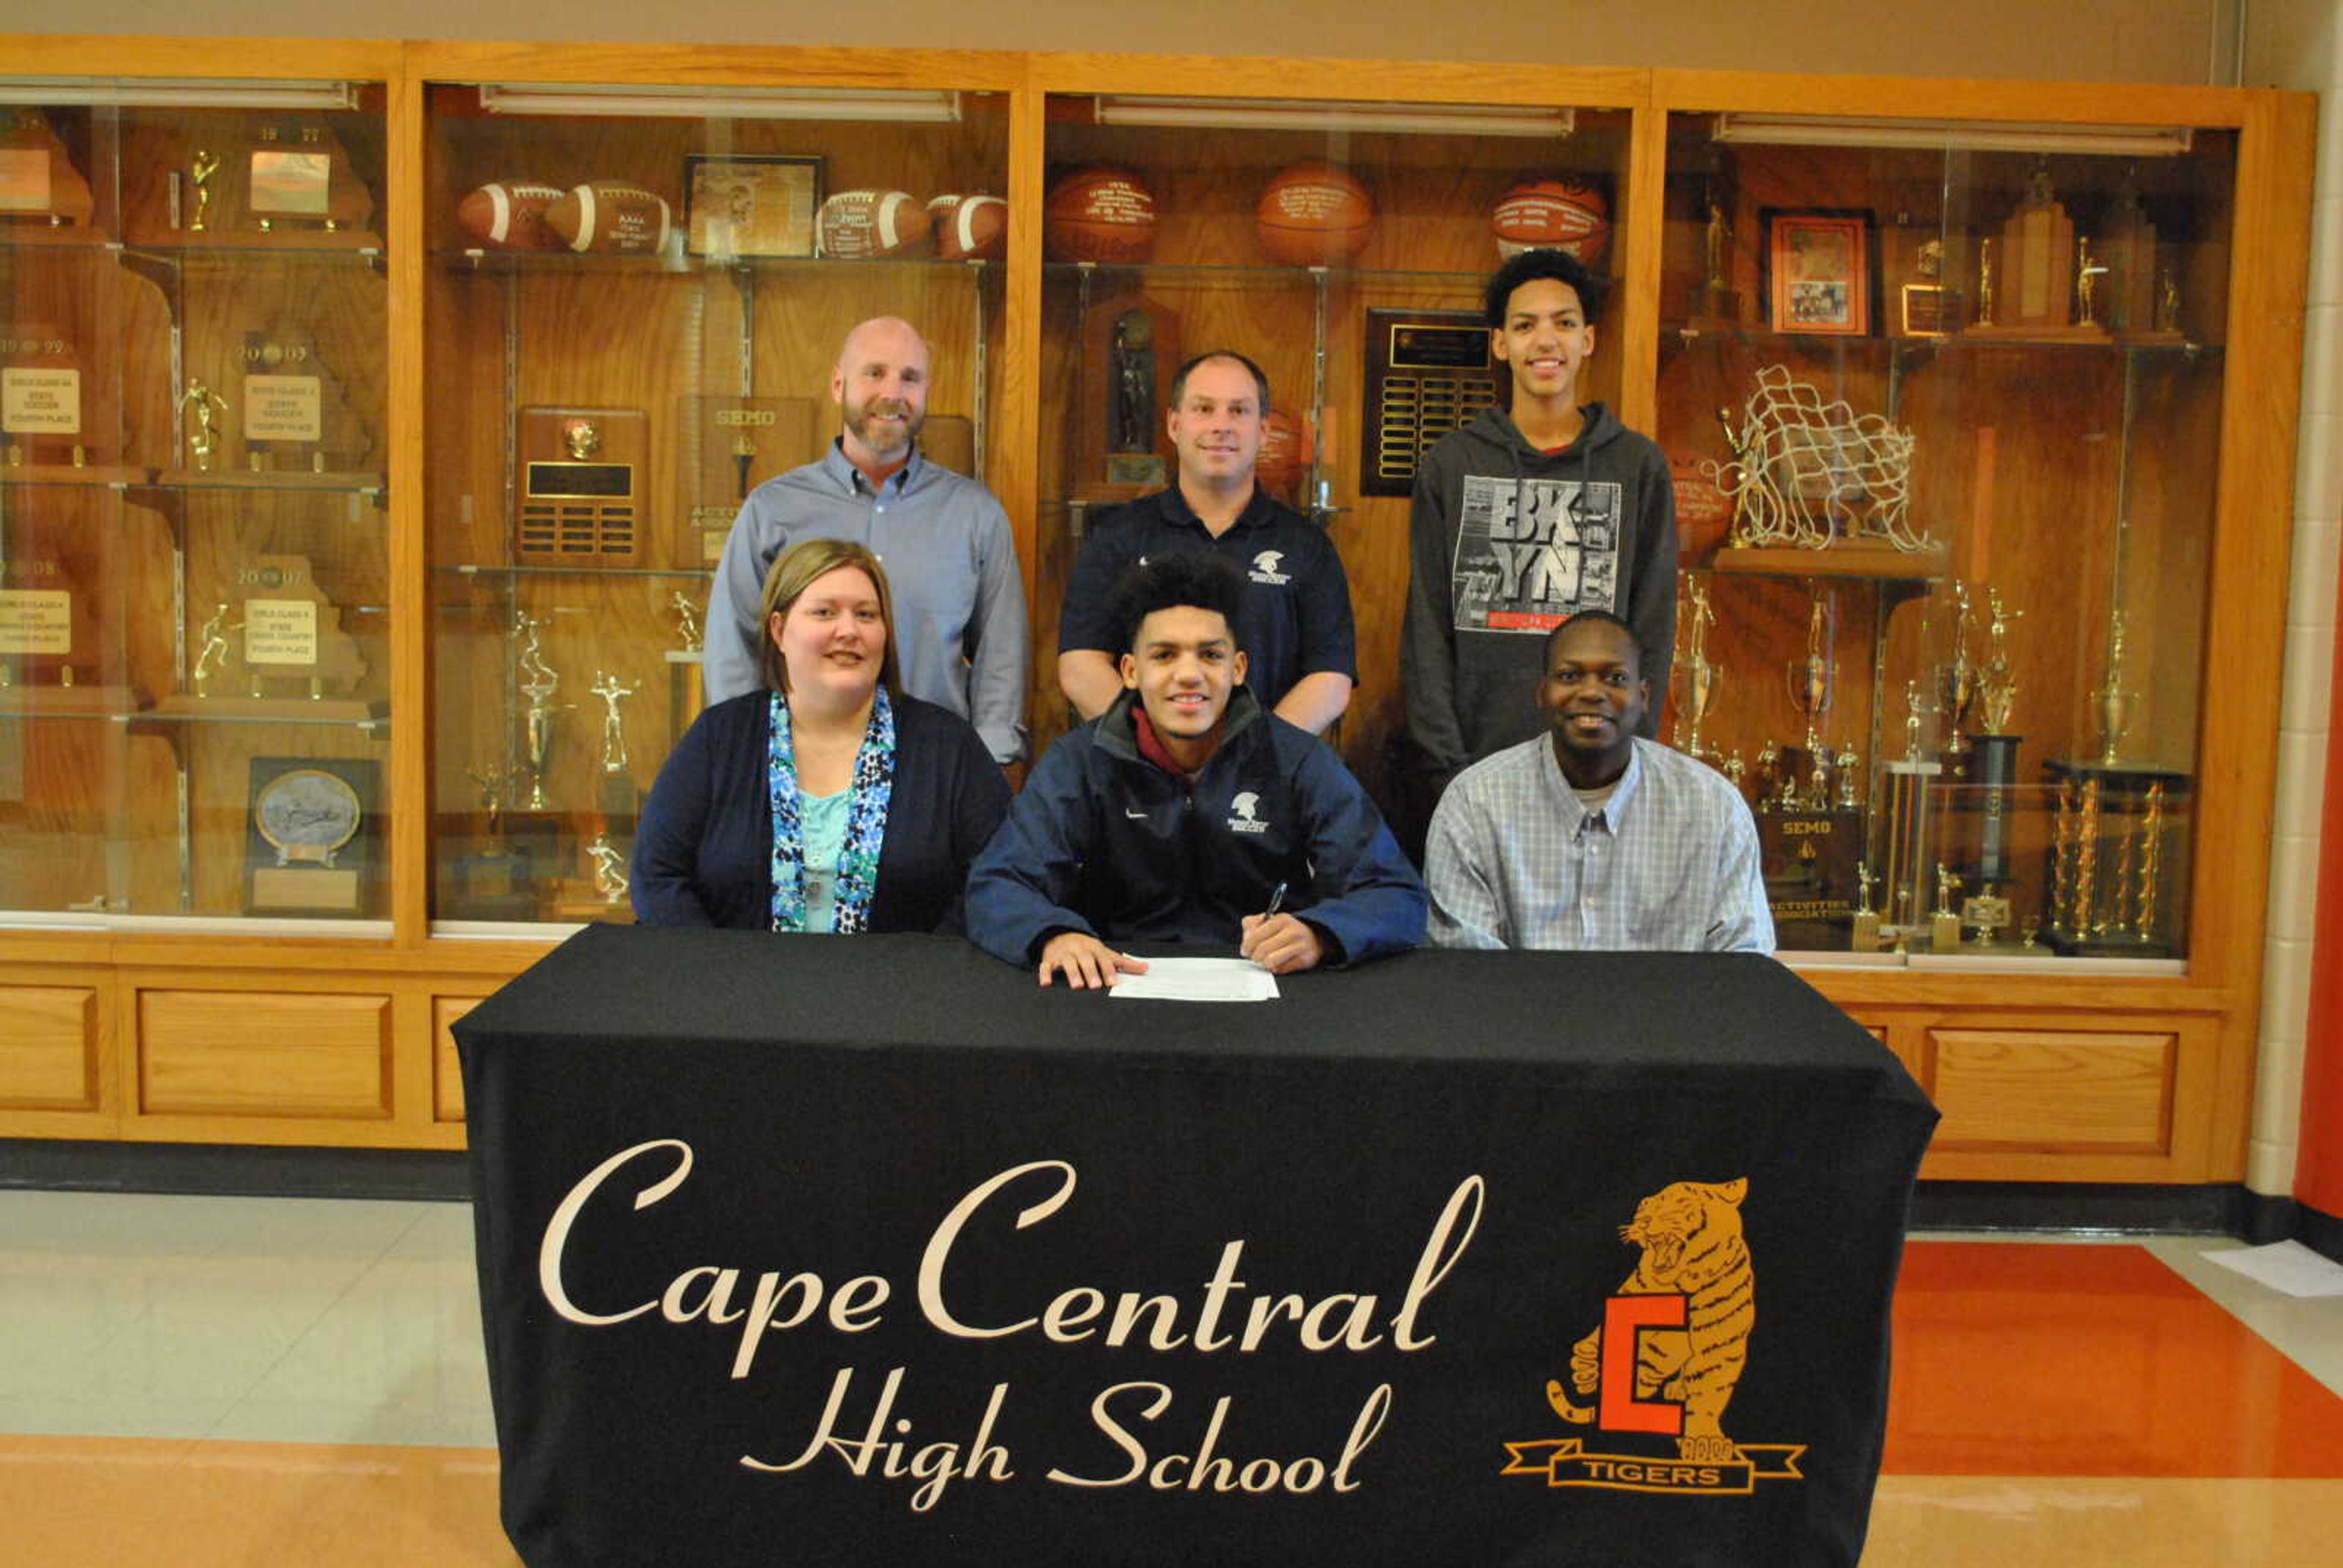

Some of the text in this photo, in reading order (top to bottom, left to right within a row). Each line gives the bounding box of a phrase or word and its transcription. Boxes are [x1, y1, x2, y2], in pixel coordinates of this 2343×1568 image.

[714, 409, 776, 426] SEMO
[1782, 821, 1832, 835] SEMO
[539, 1139, 1485, 1379] Cape Central
[740, 1367, 1392, 1512] High School
[1582, 1461, 1721, 1486] TIGERS
